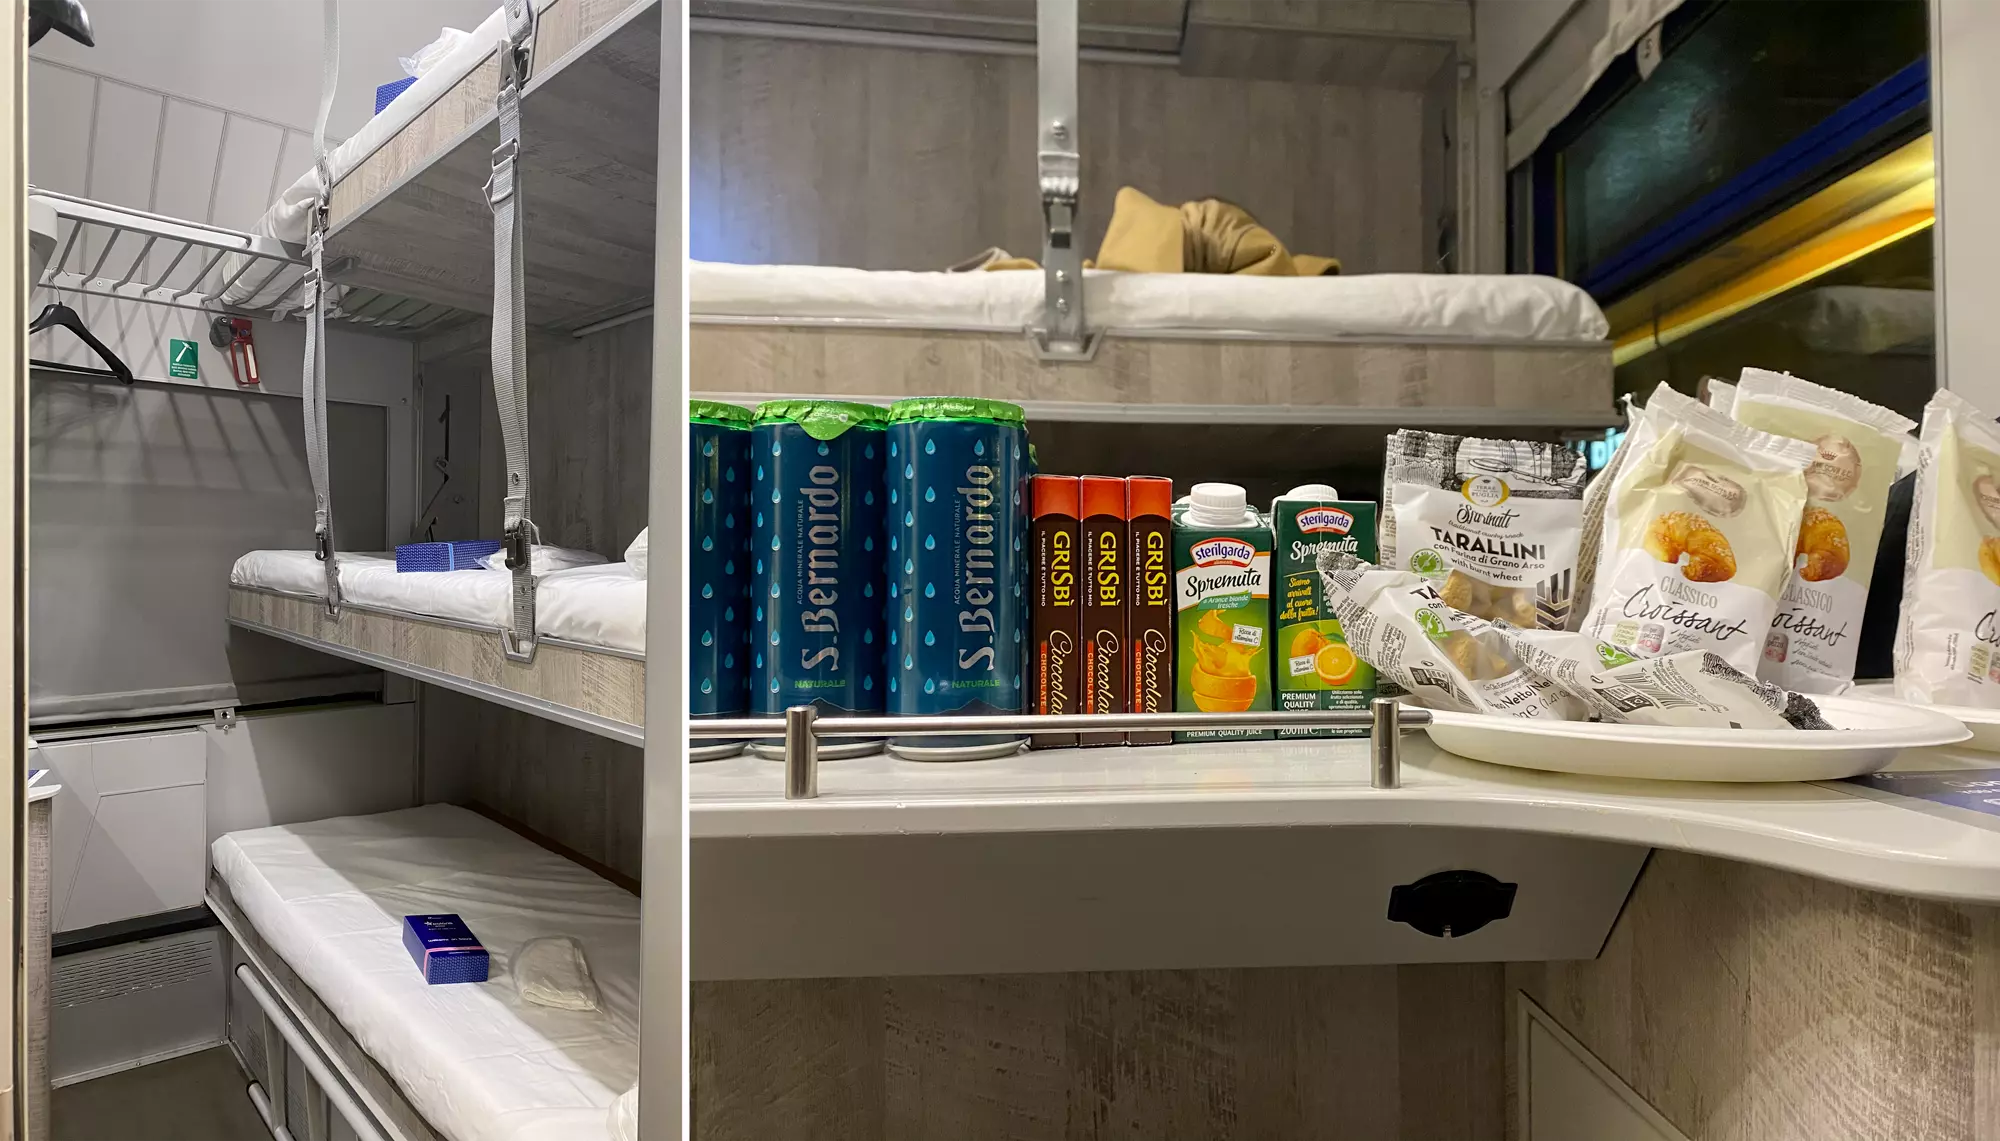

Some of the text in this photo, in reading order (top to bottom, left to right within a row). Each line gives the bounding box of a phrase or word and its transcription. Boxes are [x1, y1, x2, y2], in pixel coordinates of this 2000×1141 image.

[1300, 512, 1350, 527] sterilgarda
[1196, 543, 1250, 560] sterilgarda
[1290, 535, 1358, 564] Spremuta
[1430, 526, 1546, 560] TARALLINI
[1434, 543, 1545, 570] con Farina di Grano Arso
[1050, 530, 1074, 606] GRISBÌ
[1097, 531, 1121, 606] GRISBÌ
[1144, 531, 1168, 606] GRISBÌ
[1451, 557, 1522, 582] with burnt wheat
[1186, 568, 1261, 600] Spremuta
[1660, 576, 1718, 608] CLASSICO
[1623, 584, 1748, 640] Croissant
[1772, 608, 1846, 646] oissant
[794, 680, 846, 688] NATURALE
[952, 680, 1000, 688] NATURALE
[1284, 701, 1314, 710] QUALITY
[1218, 729, 1244, 737] QUALITY
